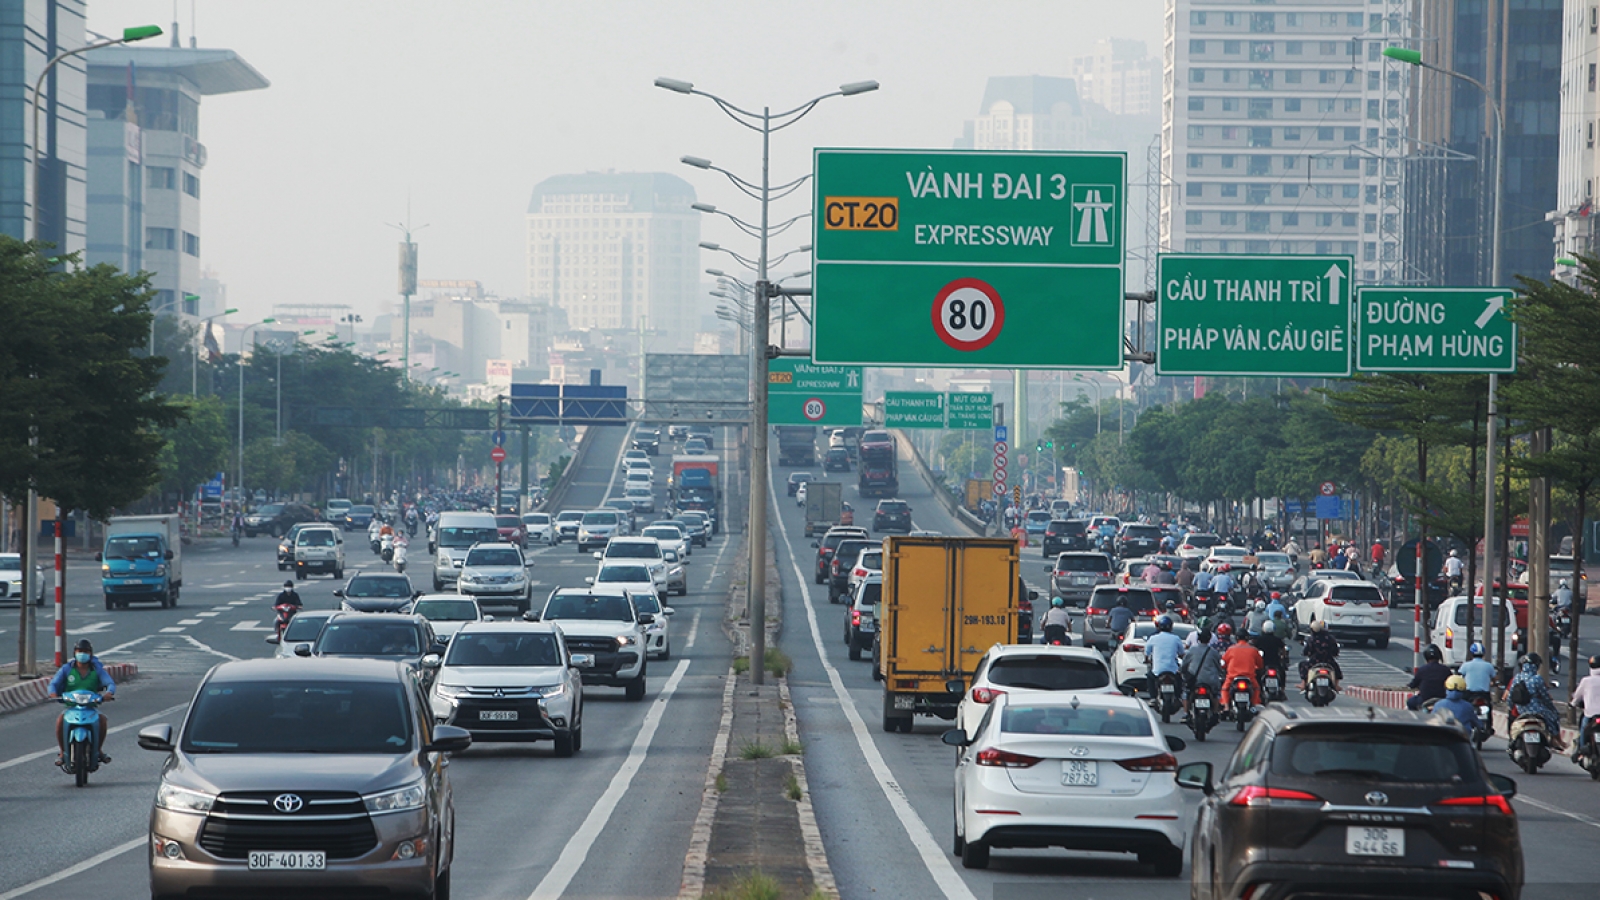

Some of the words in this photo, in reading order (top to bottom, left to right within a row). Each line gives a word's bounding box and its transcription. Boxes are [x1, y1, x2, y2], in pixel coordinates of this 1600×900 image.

[906, 165, 983, 199] VÀNH
[992, 173, 1041, 200] ĐAI
[1050, 173, 1066, 200] 3
[826, 201, 897, 229] CT.20
[914, 225, 1053, 246] EXPRESSWAY
[1166, 272, 1207, 301] CẦU
[1213, 280, 1281, 302] THANH
[1288, 275, 1321, 302] TRÌ
[949, 299, 987, 330] 80
[1366, 296, 1446, 324] ĐƯỜNG
[1164, 324, 1219, 350] PHÁP
[1368, 334, 1433, 361] PHẠM
[1442, 329, 1504, 357] HÙNG
[796, 380, 840, 388] EXPRESSWAY
[807, 404, 821, 415] 80
[964, 615, 1006, 625] 29H-193.18
[1070, 760, 1089, 772] 30E
[1363, 828, 1388, 841] 30G
[251, 852, 324, 868] 30F-401.33
